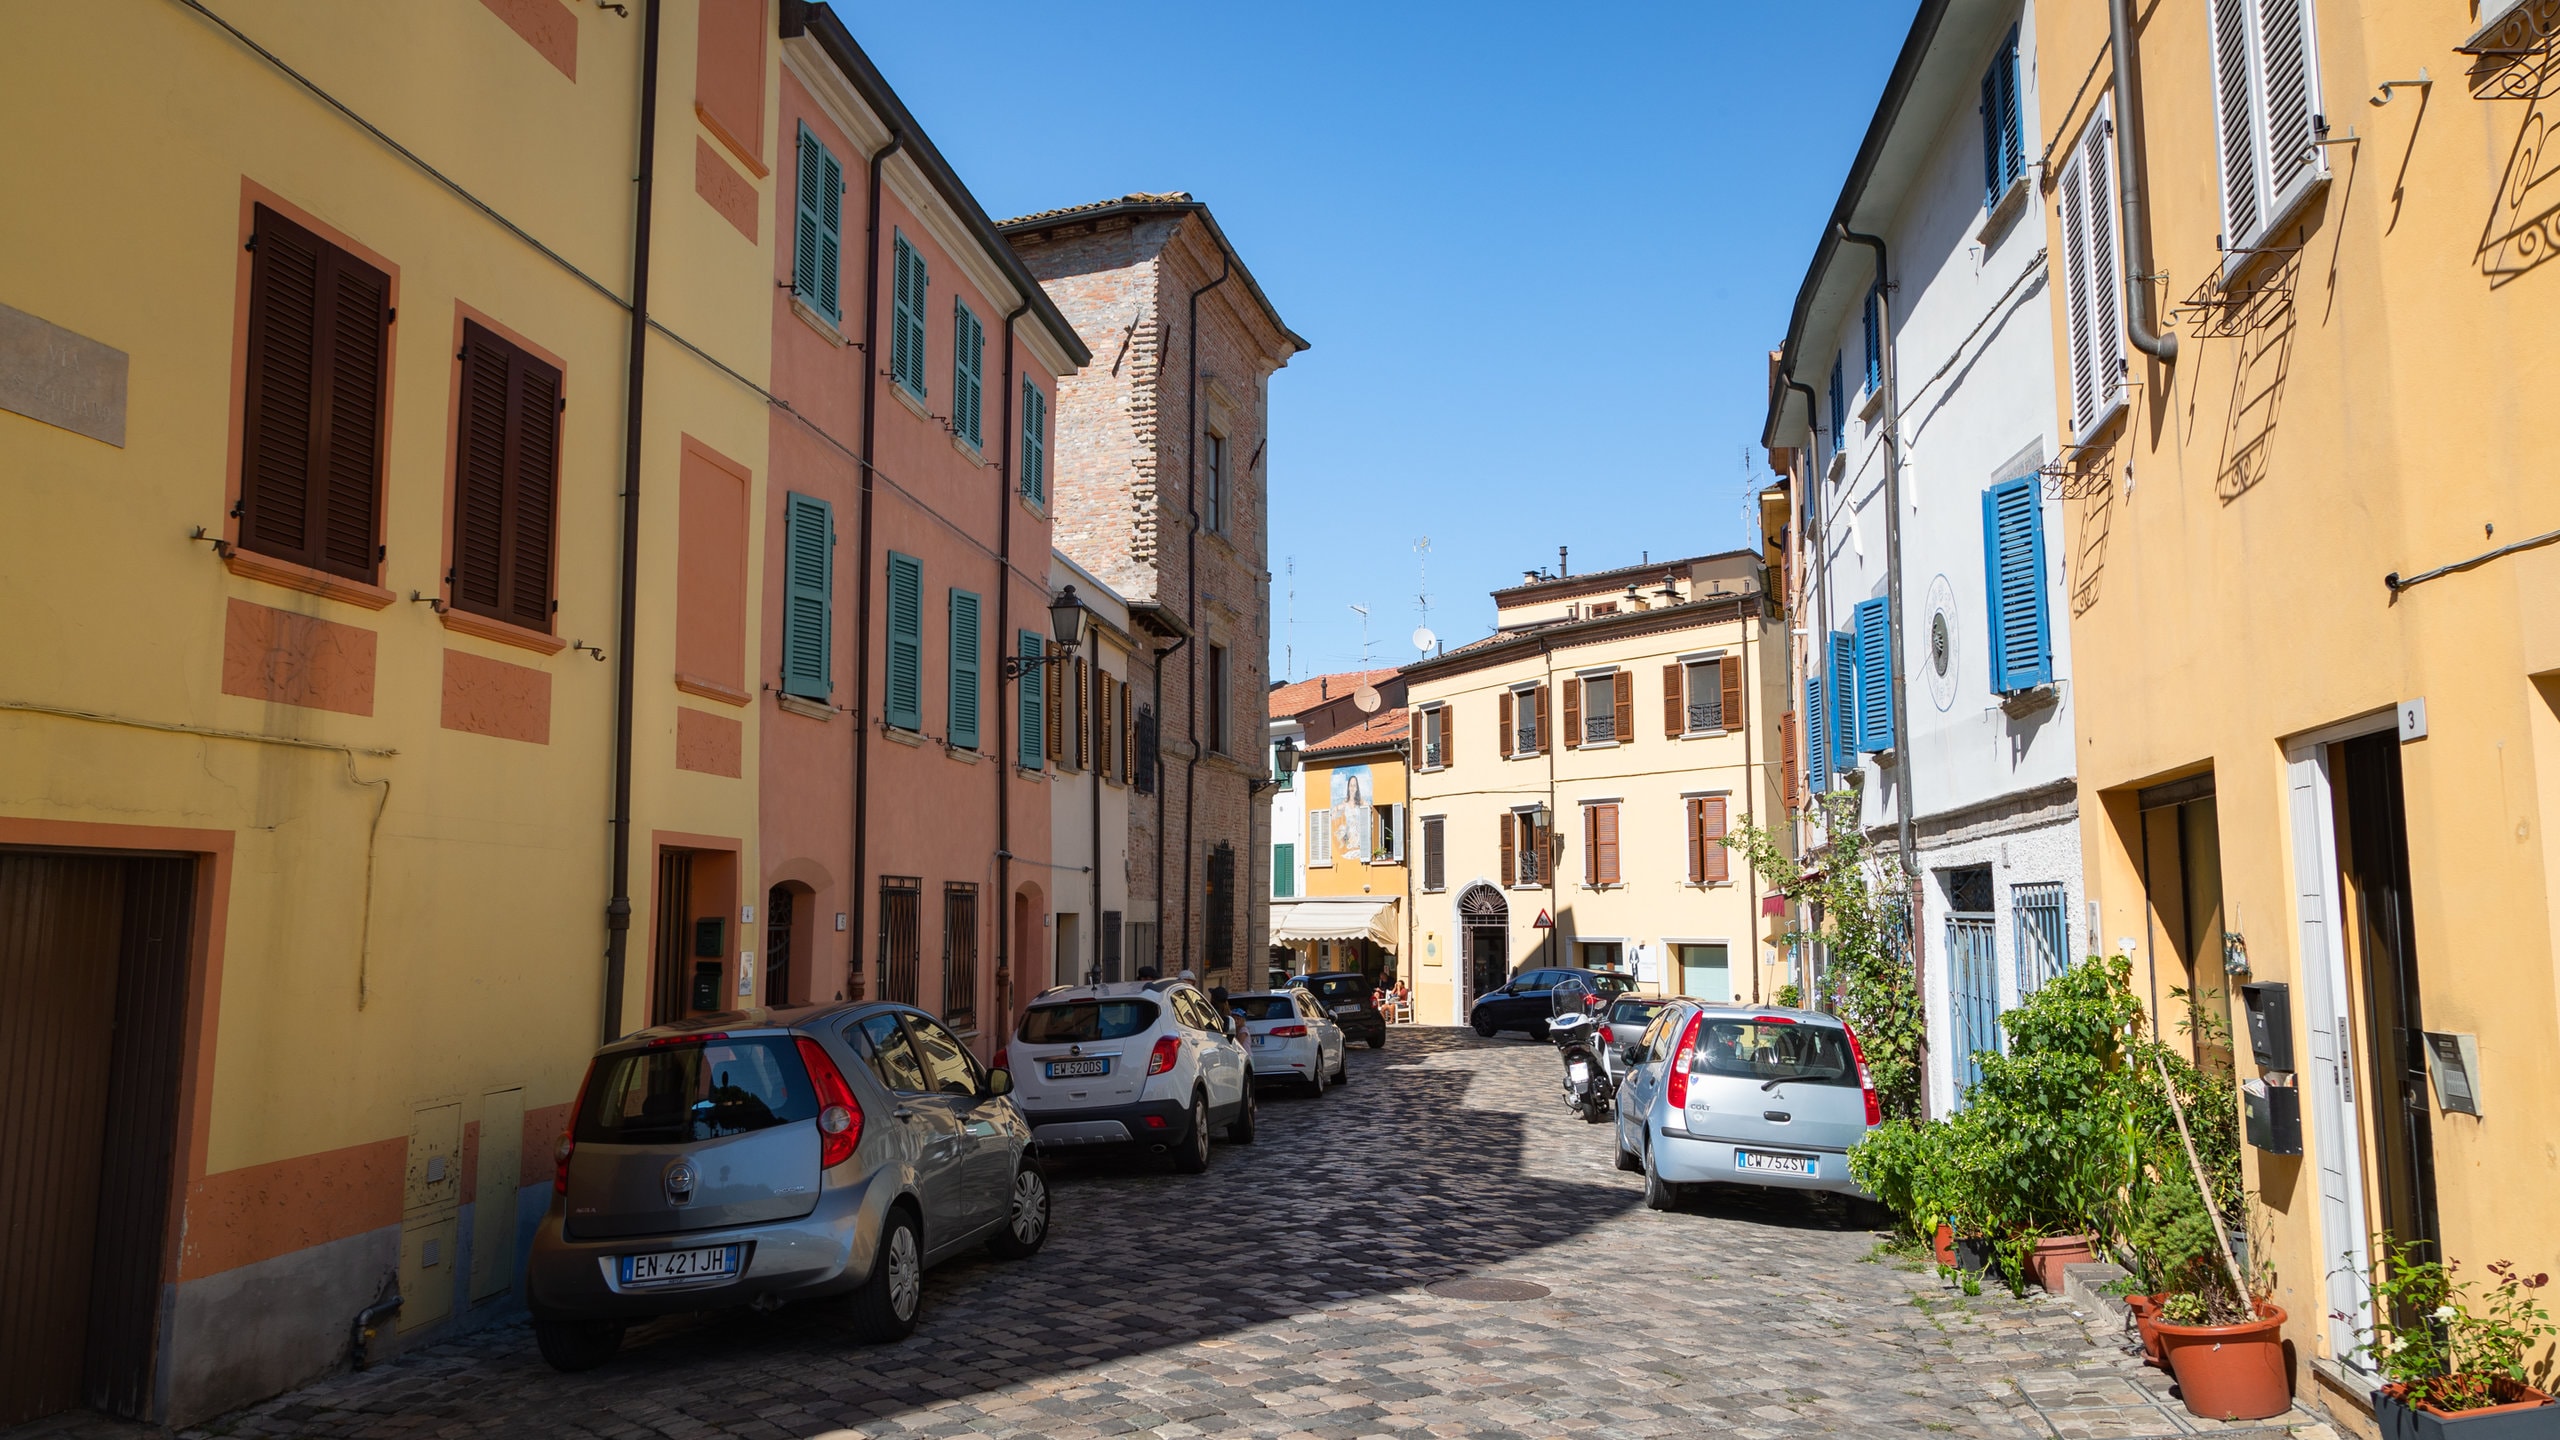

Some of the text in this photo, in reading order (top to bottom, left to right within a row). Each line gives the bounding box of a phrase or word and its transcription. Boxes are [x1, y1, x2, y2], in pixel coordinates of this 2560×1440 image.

[48, 343, 80, 372] VIA
[2407, 709, 2415, 730] 3
[1054, 1063, 1067, 1075] EW
[1070, 1061, 1102, 1074] 520DS
[1690, 1103, 1711, 1111] COLT
[1747, 1153, 1762, 1168] CW
[1767, 1155, 1806, 1171] 754SV
[635, 1255, 658, 1278] EN
[665, 1249, 724, 1275] 421JH
